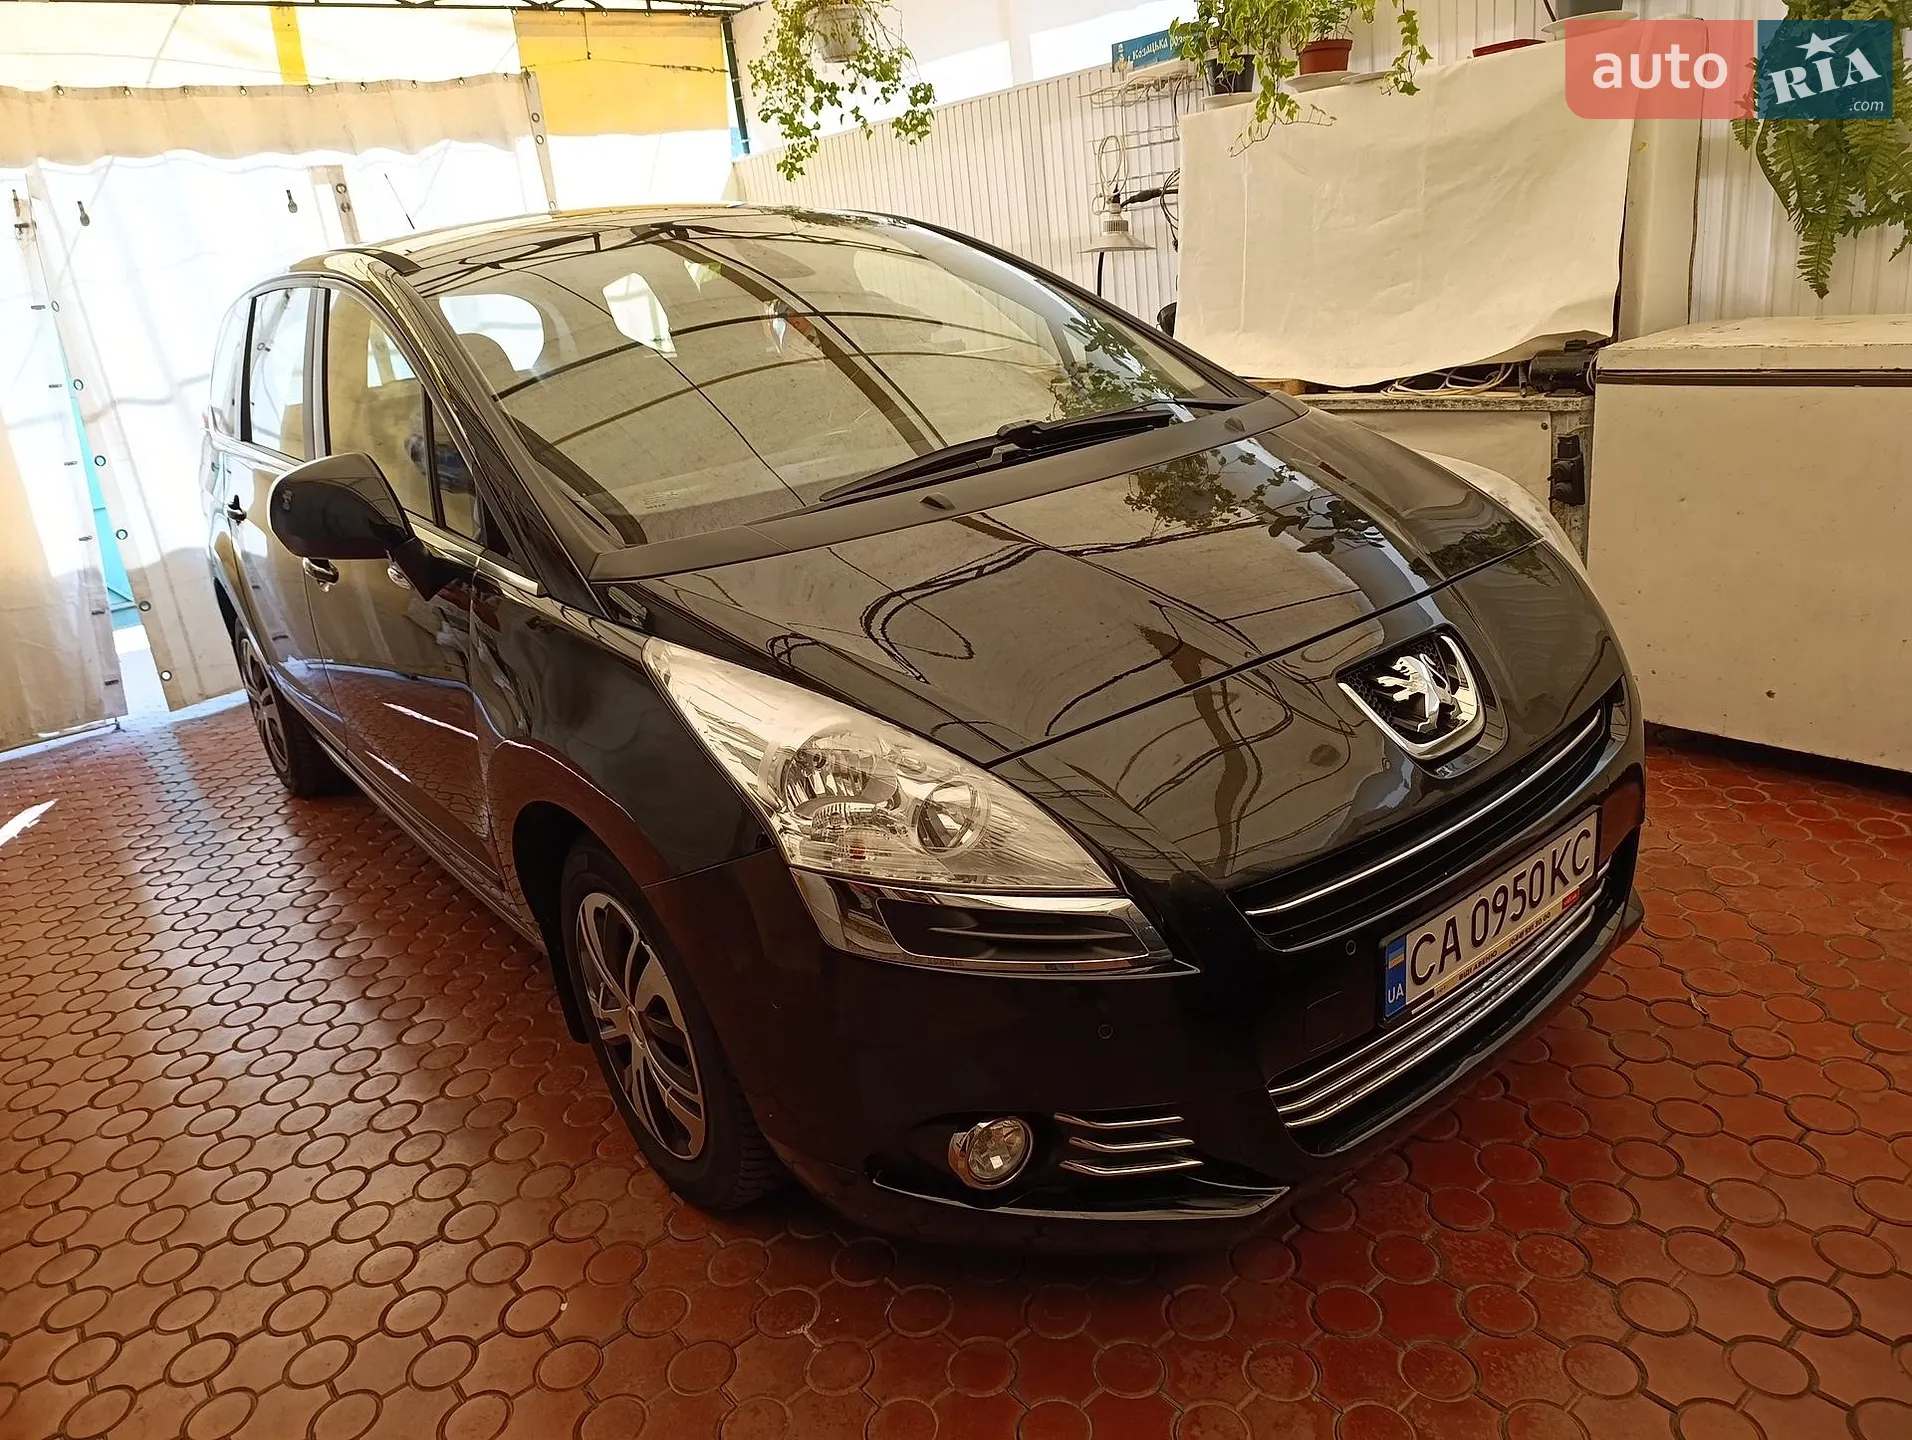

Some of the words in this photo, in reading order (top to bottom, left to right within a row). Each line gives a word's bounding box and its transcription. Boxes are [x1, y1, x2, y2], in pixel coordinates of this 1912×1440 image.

[1410, 914, 1462, 986] CA
[1470, 859, 1545, 948] 0950
[1551, 828, 1591, 896] KC
[1387, 982, 1405, 1003] UA
